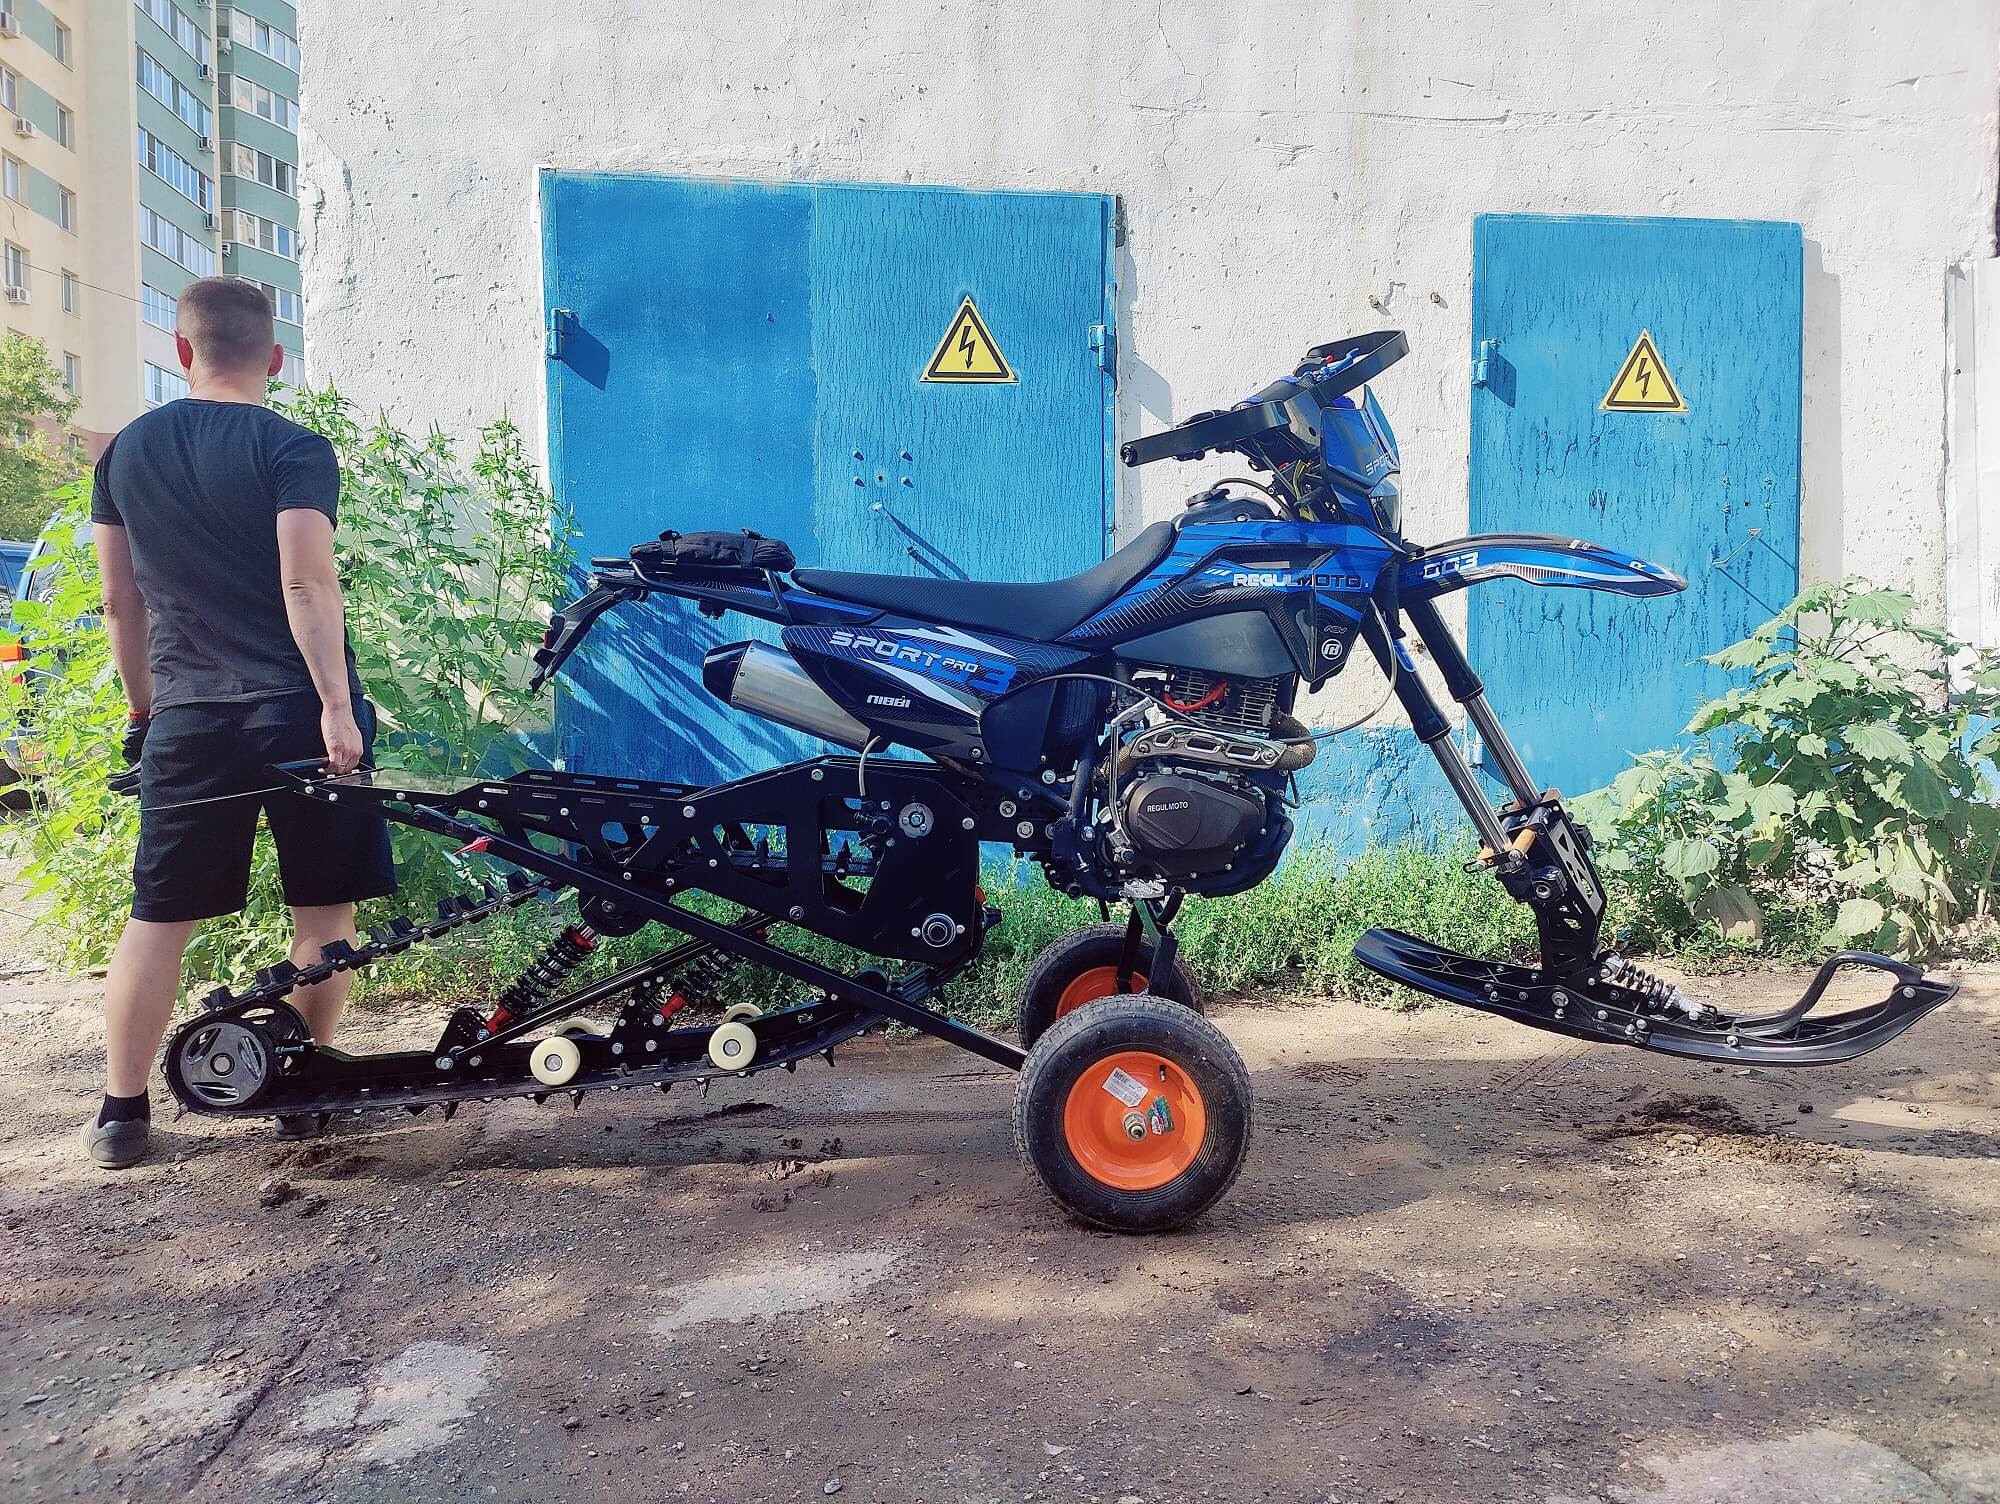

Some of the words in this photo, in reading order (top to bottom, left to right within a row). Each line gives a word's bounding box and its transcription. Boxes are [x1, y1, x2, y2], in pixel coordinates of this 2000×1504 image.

[1233, 573, 1362, 588] REGULMOTO
[829, 631, 941, 667] SPORT
[942, 657, 979, 673] PRO
[1147, 801, 1188, 812] REGULMOTO
